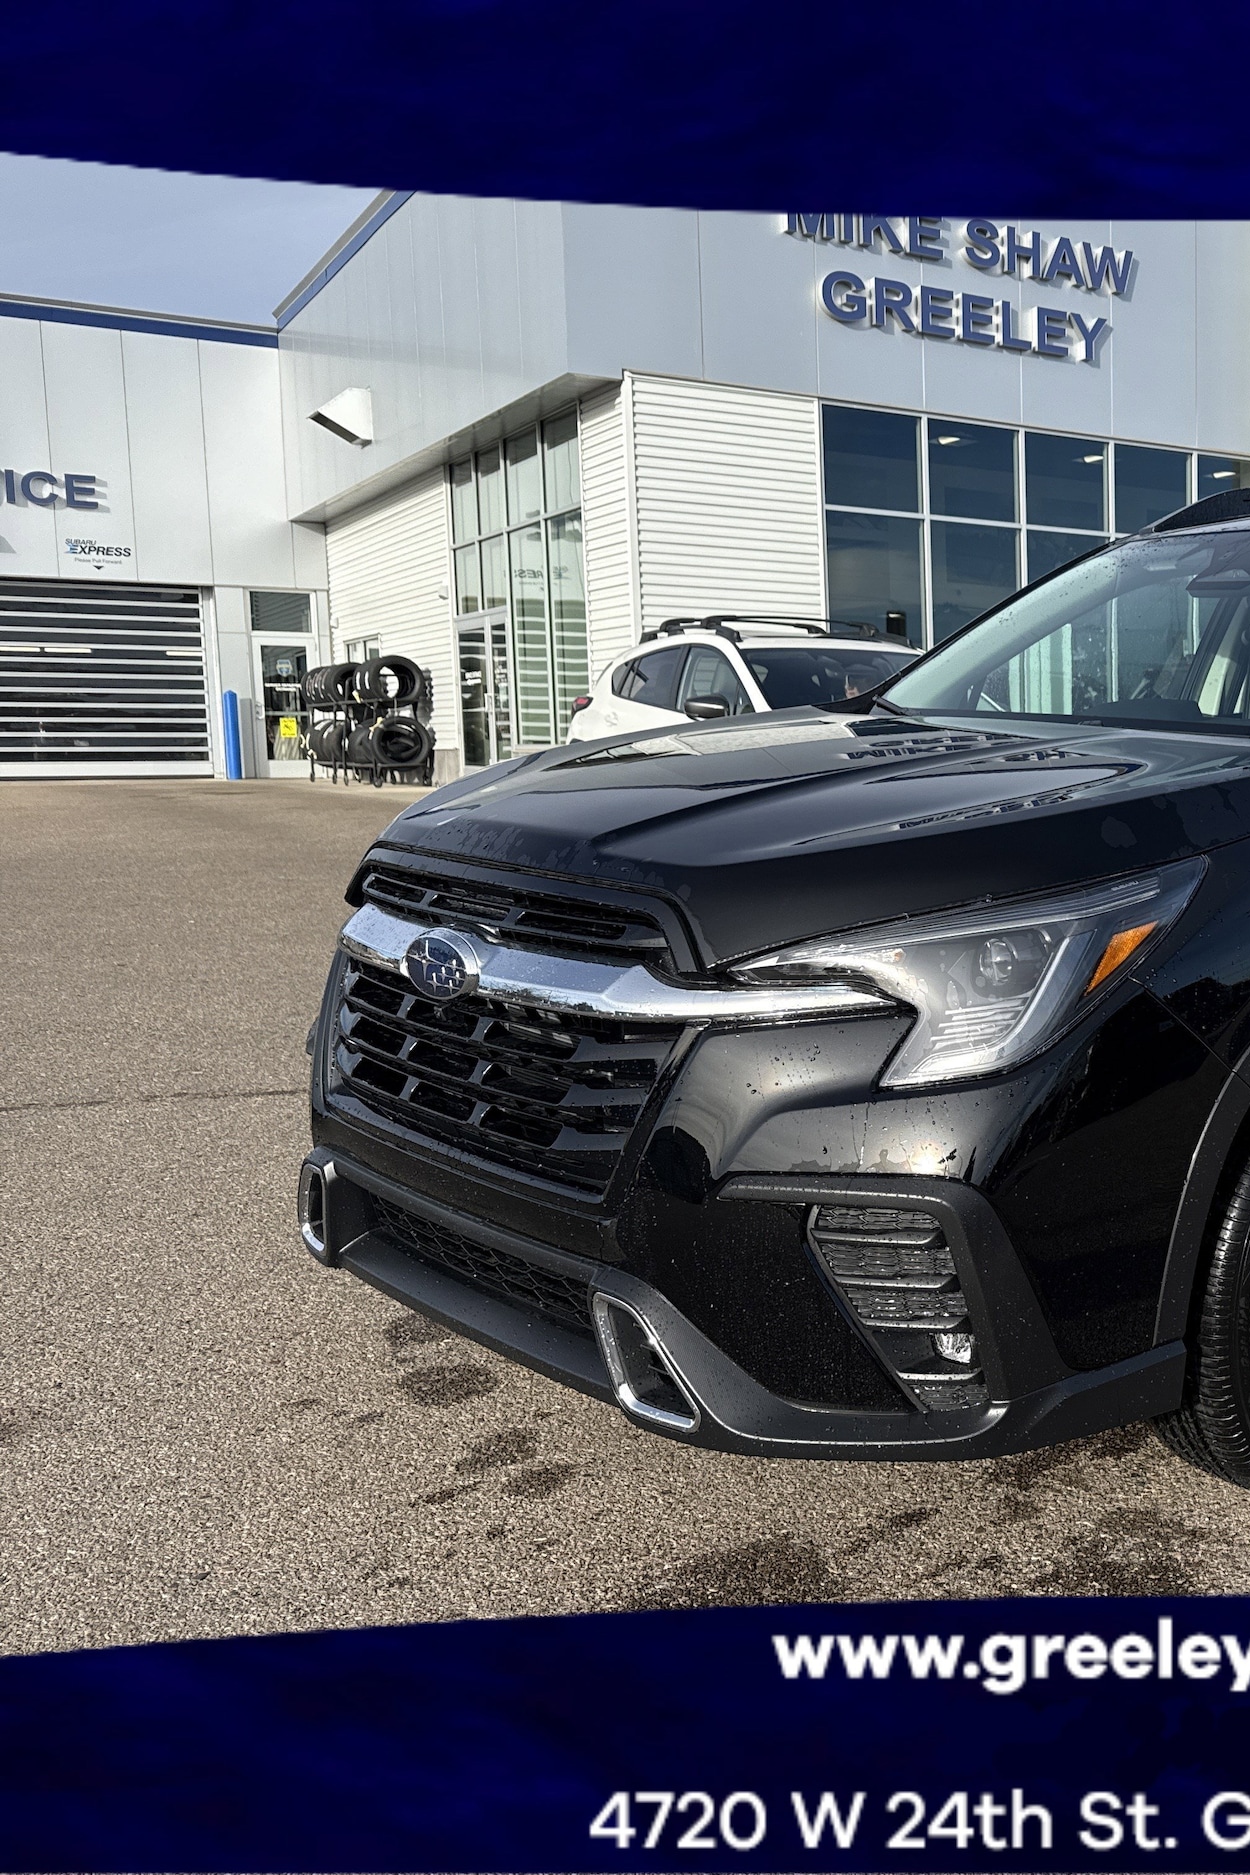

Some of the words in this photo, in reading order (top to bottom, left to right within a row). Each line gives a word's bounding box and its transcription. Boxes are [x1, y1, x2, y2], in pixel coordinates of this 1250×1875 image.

[964, 218, 1134, 294] SHAW
[820, 270, 1108, 361] GREELEY
[4, 469, 99, 510] ICE
[65, 538, 97, 546] SUBARU
[65, 544, 132, 557] EXPRESS
